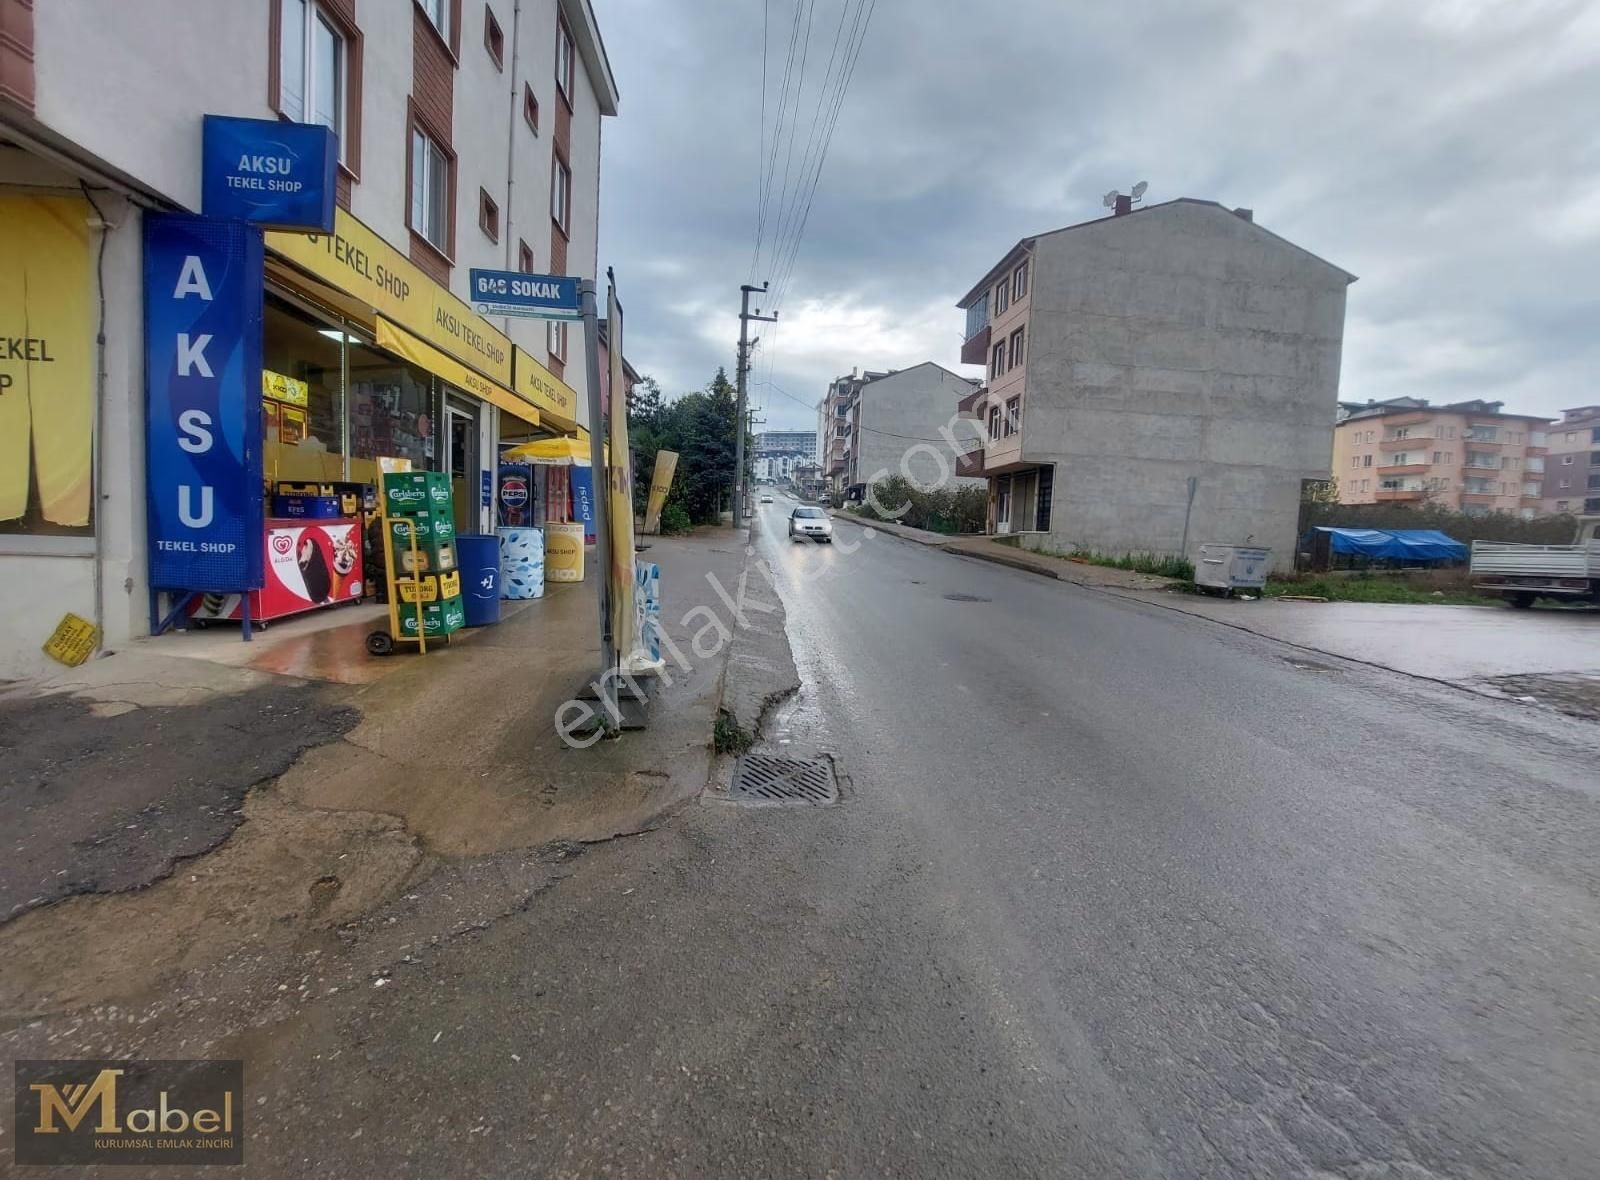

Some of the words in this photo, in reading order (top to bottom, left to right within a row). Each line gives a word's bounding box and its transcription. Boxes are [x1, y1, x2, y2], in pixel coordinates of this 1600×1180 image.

[238, 154, 291, 175] AKSU
[226, 175, 266, 190] TEKEL
[267, 179, 303, 193] SHOP
[375, 264, 410, 301] SHOP
[511, 280, 561, 299] SOKAK
[436, 307, 460, 337] AKSU
[461, 324, 486, 356] TEKEL
[486, 342, 504, 366] SHOP
[465, 373, 479, 391] AKSU
[480, 381, 493, 396] SHOP
[530, 373, 543, 393] AKSU
[543, 382, 557, 403] TEKEL
[389, 488, 426, 502] Carlsberg
[502, 490, 526, 498] PEPSI
[578, 486, 592, 521] pepsi
[157, 541, 197, 552] TEKEL
[200, 542, 236, 553] SHOP
